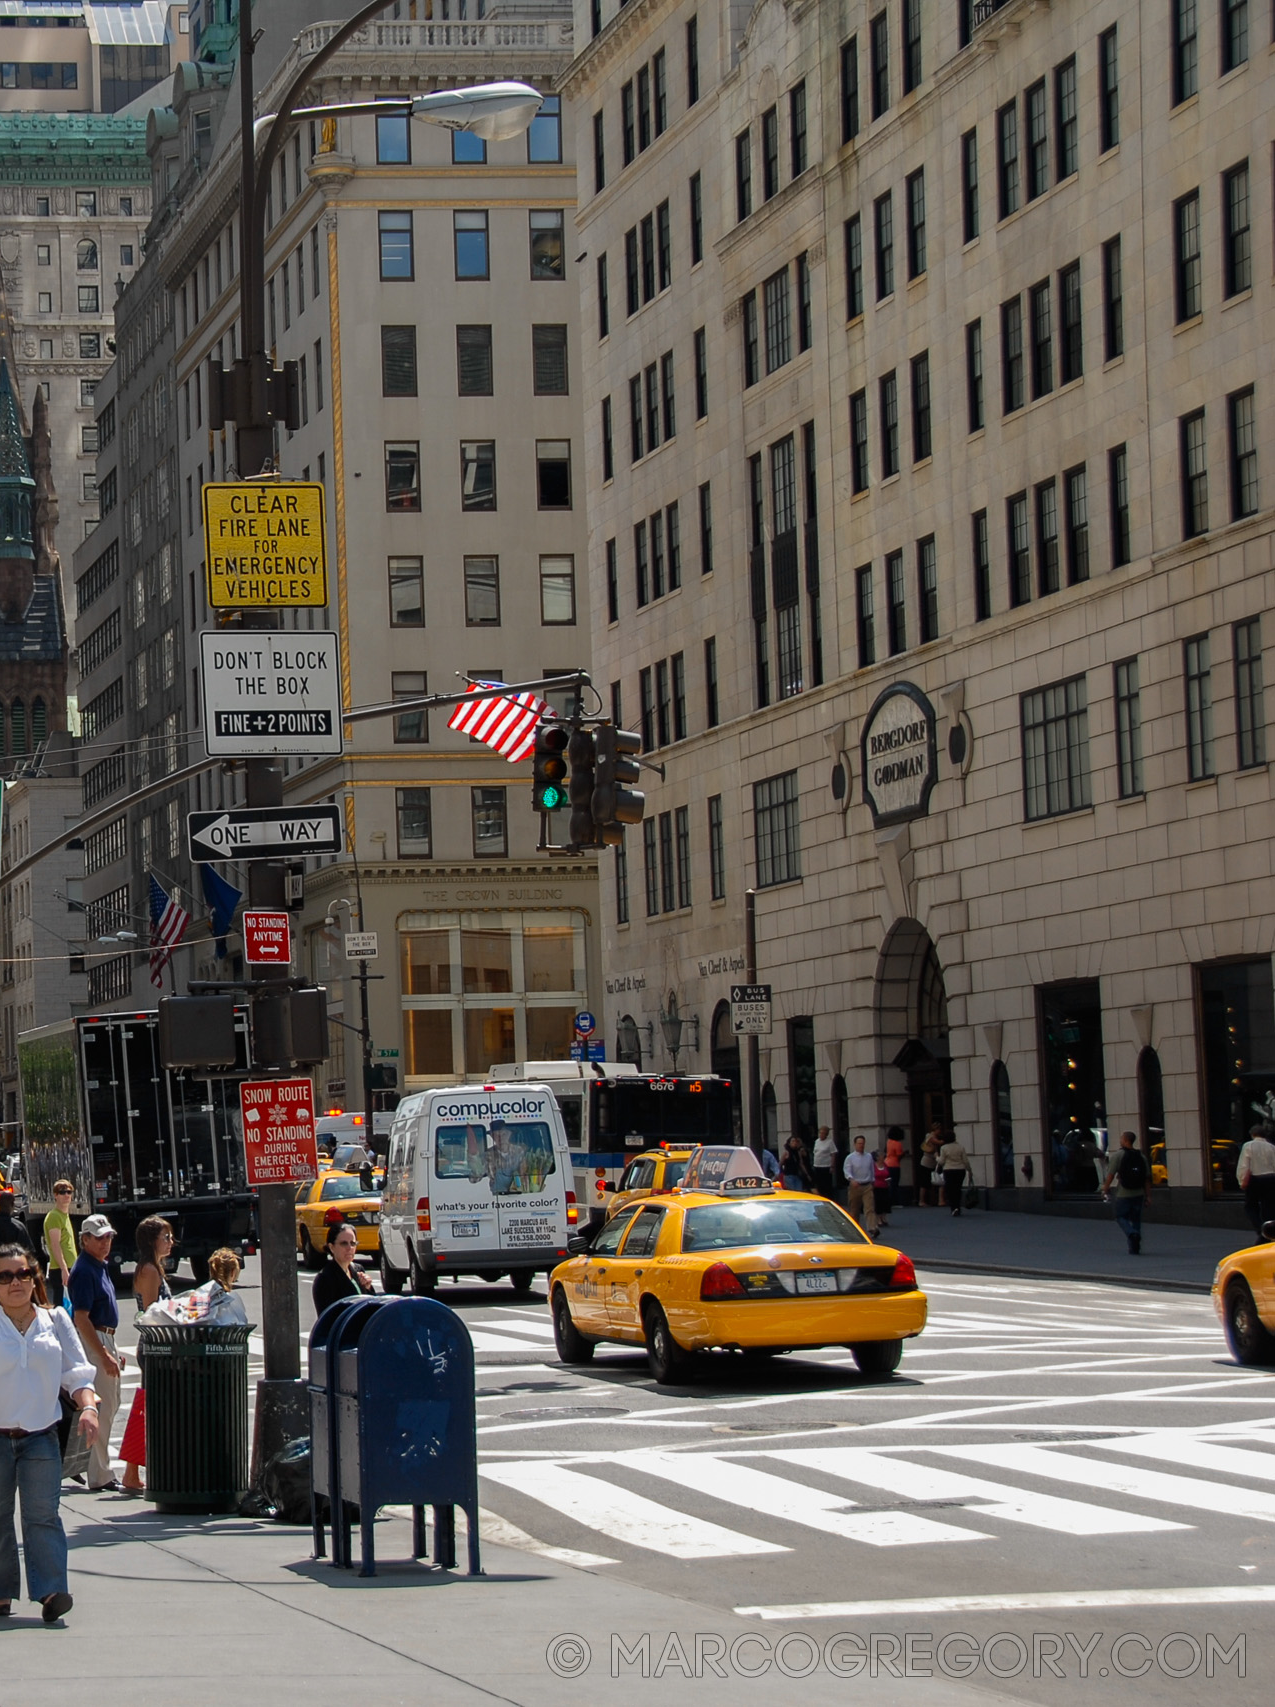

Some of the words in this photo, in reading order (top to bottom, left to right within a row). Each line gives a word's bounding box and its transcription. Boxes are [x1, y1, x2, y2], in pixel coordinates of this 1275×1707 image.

[230, 495, 298, 513] CLEAR
[219, 519, 258, 537] FIRE
[267, 519, 310, 536] LANE
[254, 540, 278, 553] FOR
[214, 556, 319, 575] EMERGENCY
[225, 580, 311, 598] VEHICLES
[214, 651, 263, 670] DON'T
[273, 651, 327, 669] BLOCK
[235, 677, 267, 695] THE
[276, 677, 310, 695] BOX
[278, 713, 326, 733] POINTS
[870, 719, 926, 755] BERGDORF
[874, 754, 924, 787] GOODMAN
[210, 825, 251, 846] ONE
[279, 821, 322, 841] WAY
[422, 890, 448, 902] THE
[455, 889, 500, 901] CROWN
[507, 889, 562, 901] BUILDING
[247, 917, 257, 928] NO
[258, 917, 286, 929] STANDING
[253, 931, 284, 942] ANYTIME
[697, 961, 708, 977] Van
[708, 957, 722, 974] Cleef
[722, 956, 728, 972] &
[728, 954, 745, 976] Arpels
[605, 980, 614, 994] Van
[650, 1081, 675, 1091] 6676
[244, 1088, 272, 1104] SNOW
[278, 1086, 310, 1102] ROUTE
[436, 1098, 546, 1120] compucolor
[247, 1127, 261, 1143] NO
[266, 1124, 312, 1142] STANDING
[264, 1142, 297, 1154] DURING
[254, 1153, 308, 1167] EMERGENCY
[254, 1167, 285, 1179] VEHICLES
[289, 1166, 312, 1177] TOWED
[735, 1178, 757, 1188] 4L22
[435, 1202, 466, 1211] what's
[468, 1202, 488, 1211] your
[491, 1200, 527, 1209] favorite
[529, 1198, 559, 1208] color?
[520, 1218, 539, 1226] MARCUS
[539, 1218, 548, 1226] AVE
[501, 1227, 514, 1235] LAKE
[514, 1226, 536, 1235] SUCCESS,
[205, 1344, 223, 1352] Fifth
